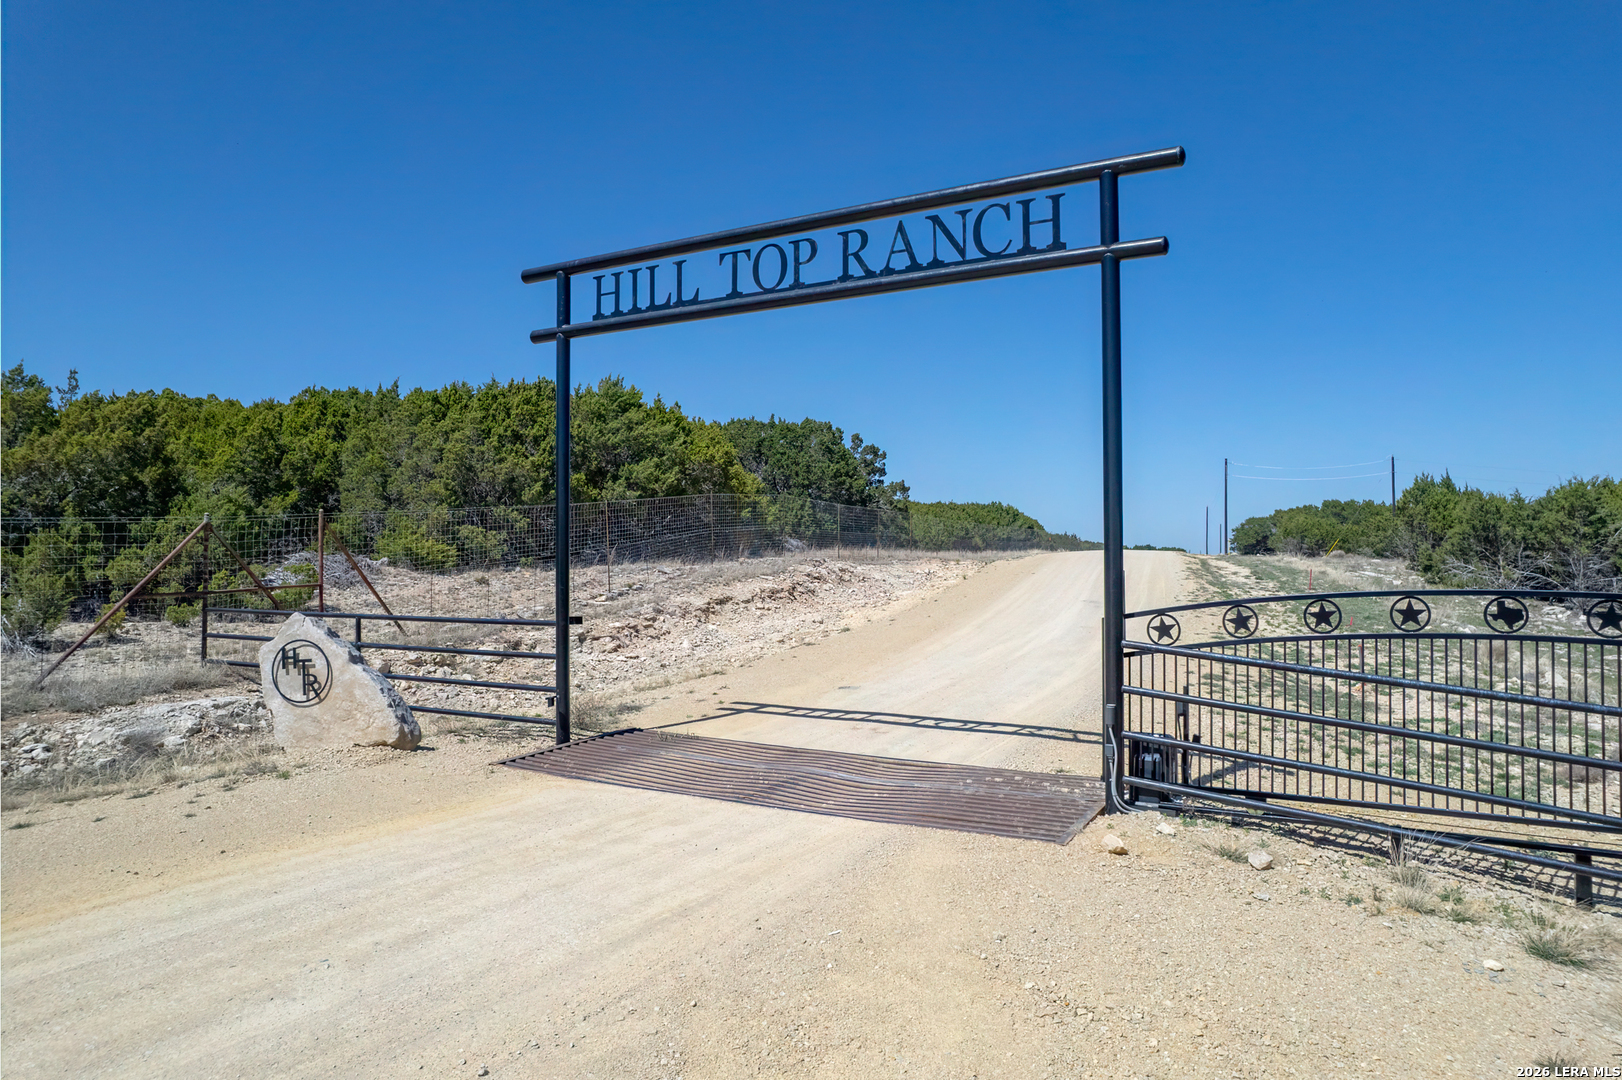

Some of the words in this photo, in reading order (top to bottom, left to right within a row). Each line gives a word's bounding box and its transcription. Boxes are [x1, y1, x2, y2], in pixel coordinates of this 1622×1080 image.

[592, 259, 700, 322] HILL
[719, 237, 819, 299] TOP
[837, 192, 1067, 284] RANCH
